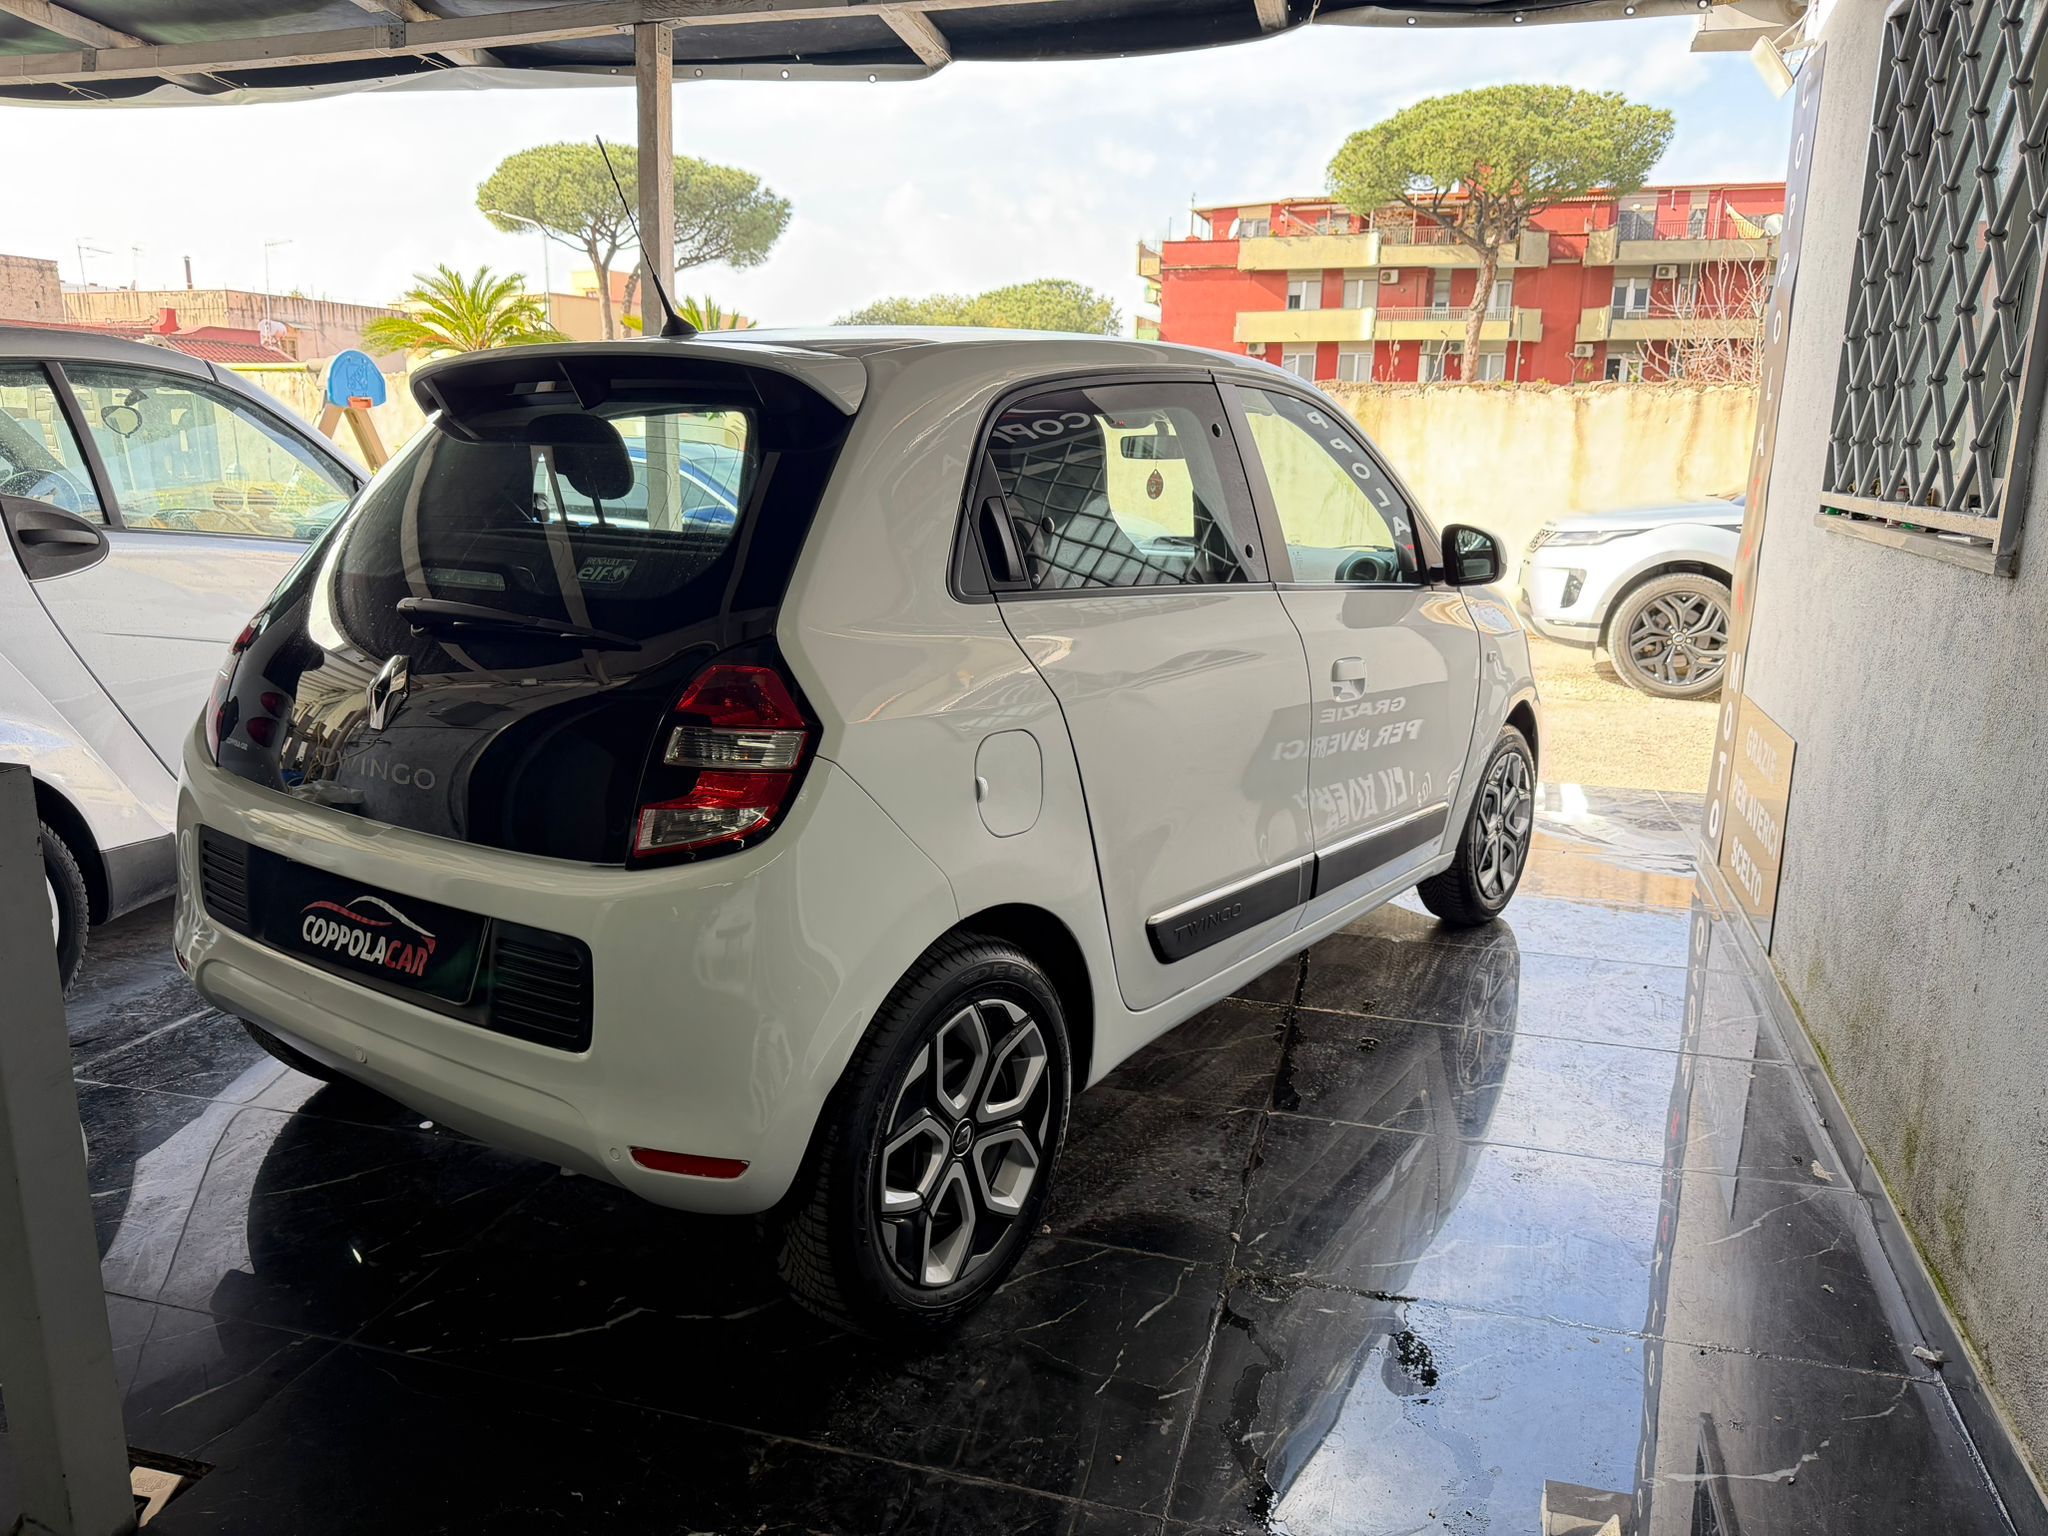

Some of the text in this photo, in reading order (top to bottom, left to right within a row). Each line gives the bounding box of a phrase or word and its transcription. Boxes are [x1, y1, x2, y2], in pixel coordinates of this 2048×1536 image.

[1755, 71, 1812, 458] COPPOLA
[577, 566, 614, 581] elf
[1709, 651, 1742, 838] MOTO
[1733, 772, 1780, 861] PER AVERCI
[1731, 836, 1762, 906] SCELTO
[302, 914, 428, 977] COPPOLACAR
[1173, 902, 1243, 942] TWINGO
